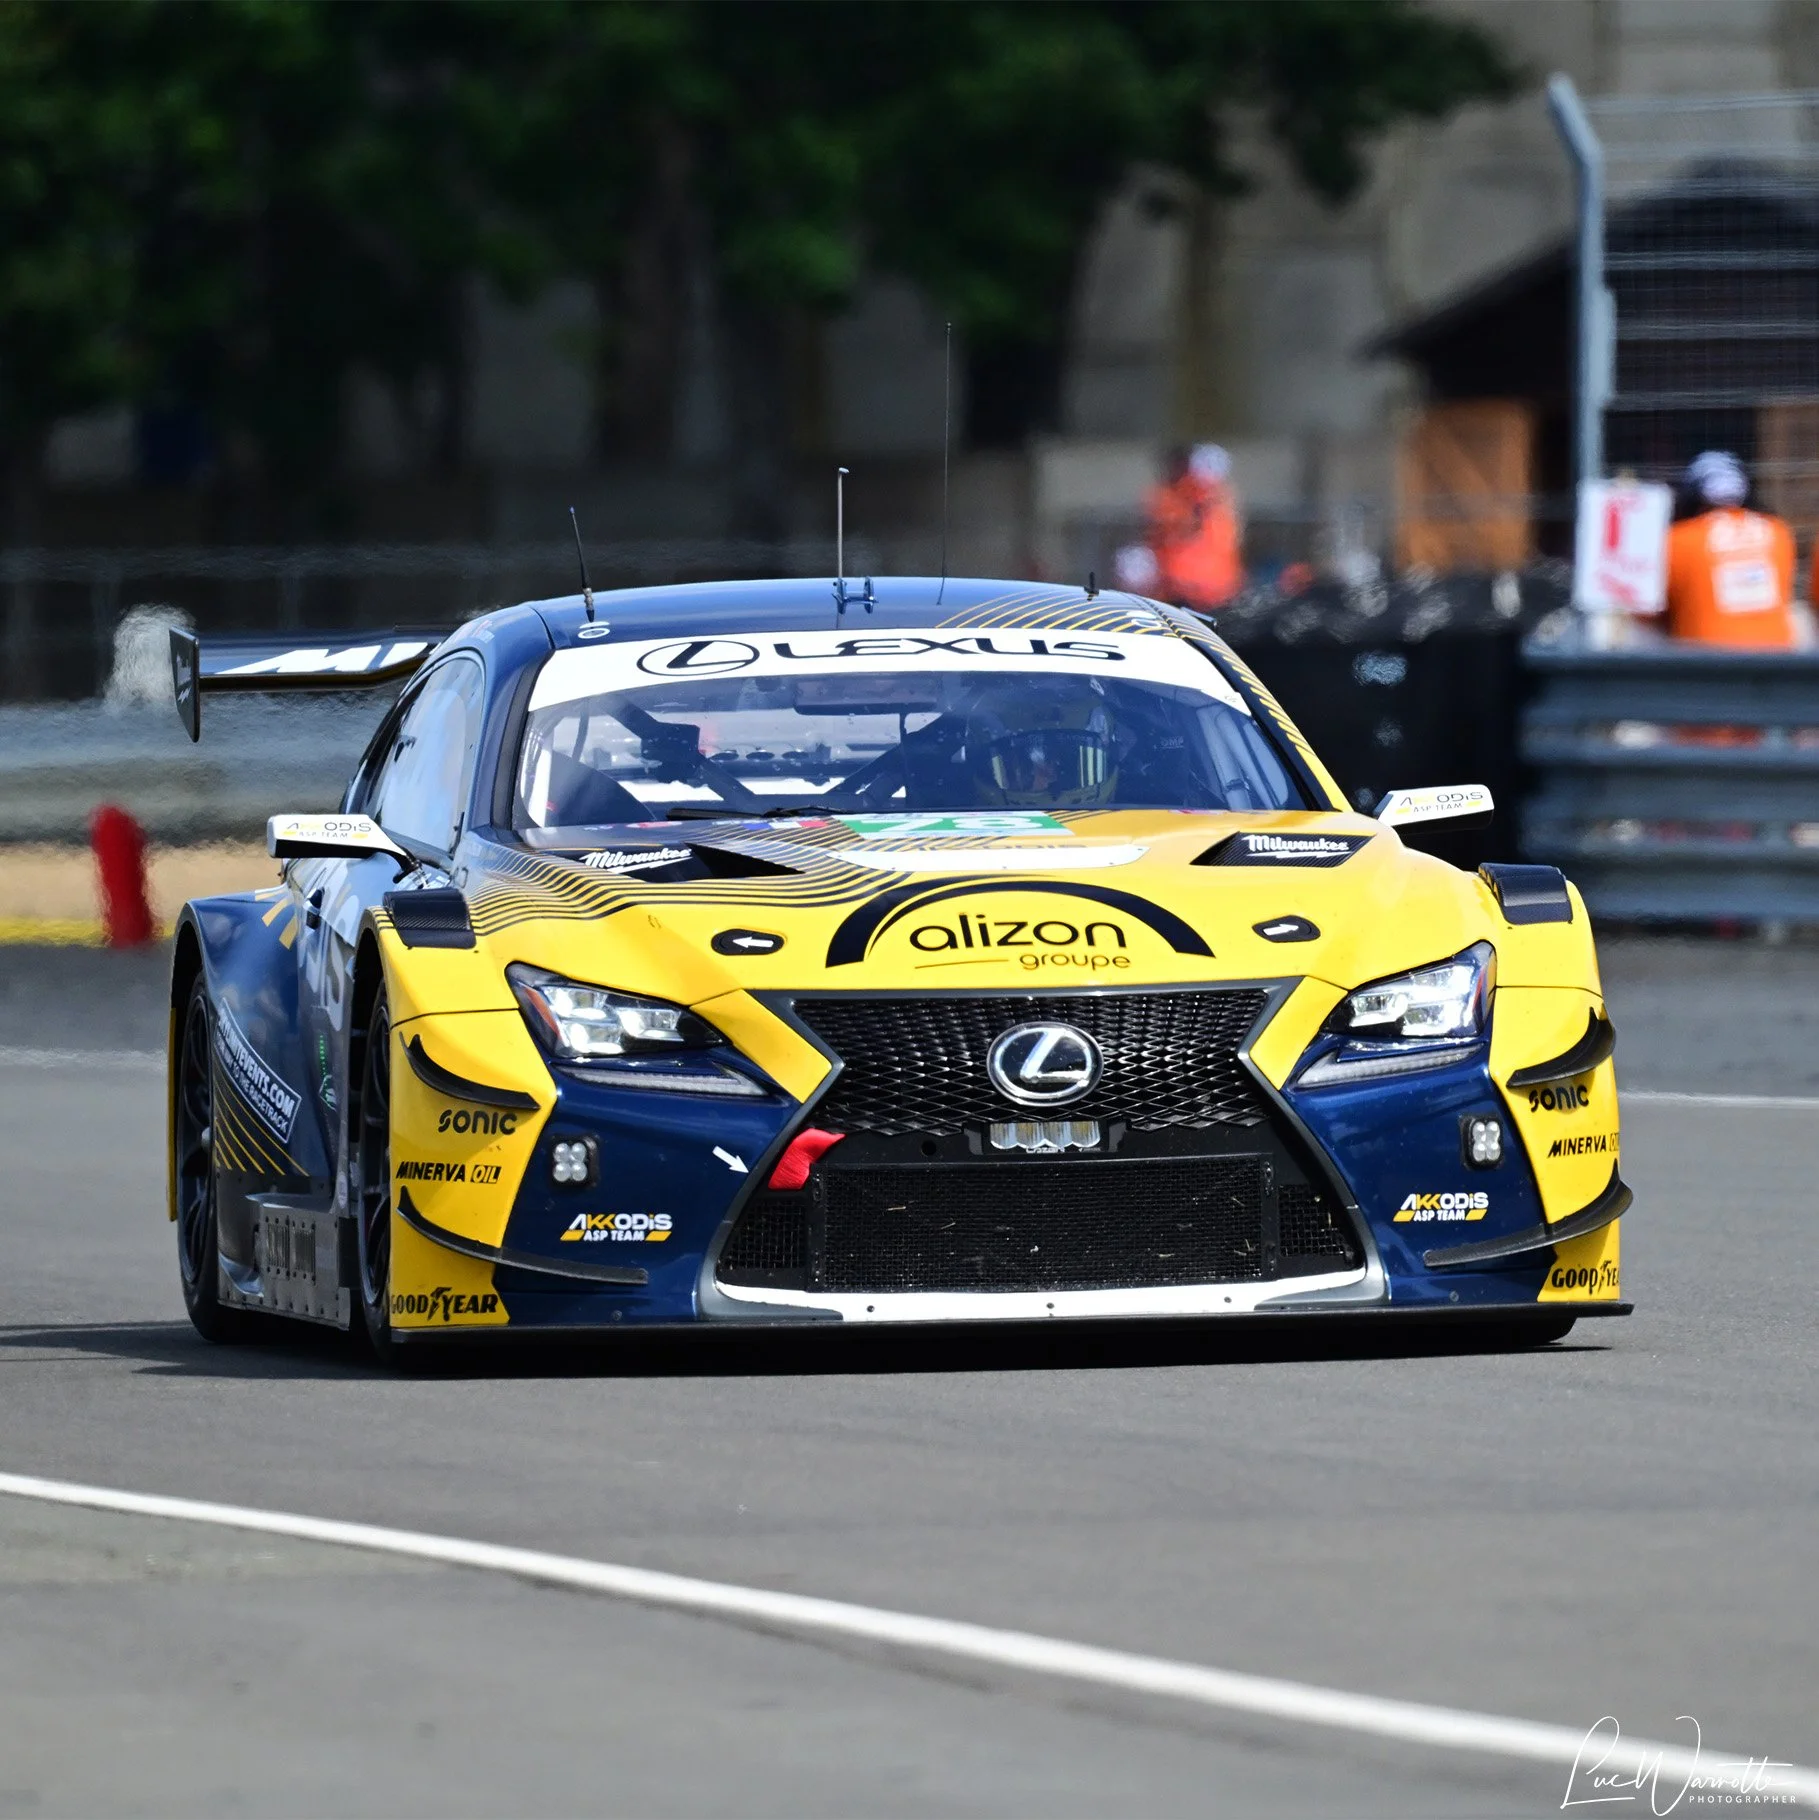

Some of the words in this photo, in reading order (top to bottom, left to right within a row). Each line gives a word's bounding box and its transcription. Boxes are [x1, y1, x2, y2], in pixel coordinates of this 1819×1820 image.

[773, 638, 1126, 661] LEXUS
[1435, 803, 1463, 812] TEAM
[860, 816, 1044, 833] 78
[1241, 834, 1349, 852] Milwaukee
[579, 848, 692, 869] Milwaukee
[910, 914, 1126, 951] alizon
[1019, 953, 1131, 971] groupe
[249, 1086, 288, 1133] RACETRACK
[1547, 1135, 1607, 1159] MINERVA
[396, 1161, 466, 1182] MINERVA
[471, 1165, 502, 1184] OIL
[1413, 1210, 1436, 1222] ASP
[1437, 1209, 1466, 1221] TEAM
[583, 1230, 609, 1242] ASP
[610, 1230, 645, 1242] TEAM
[1552, 1261, 1619, 1295] GOODYE
